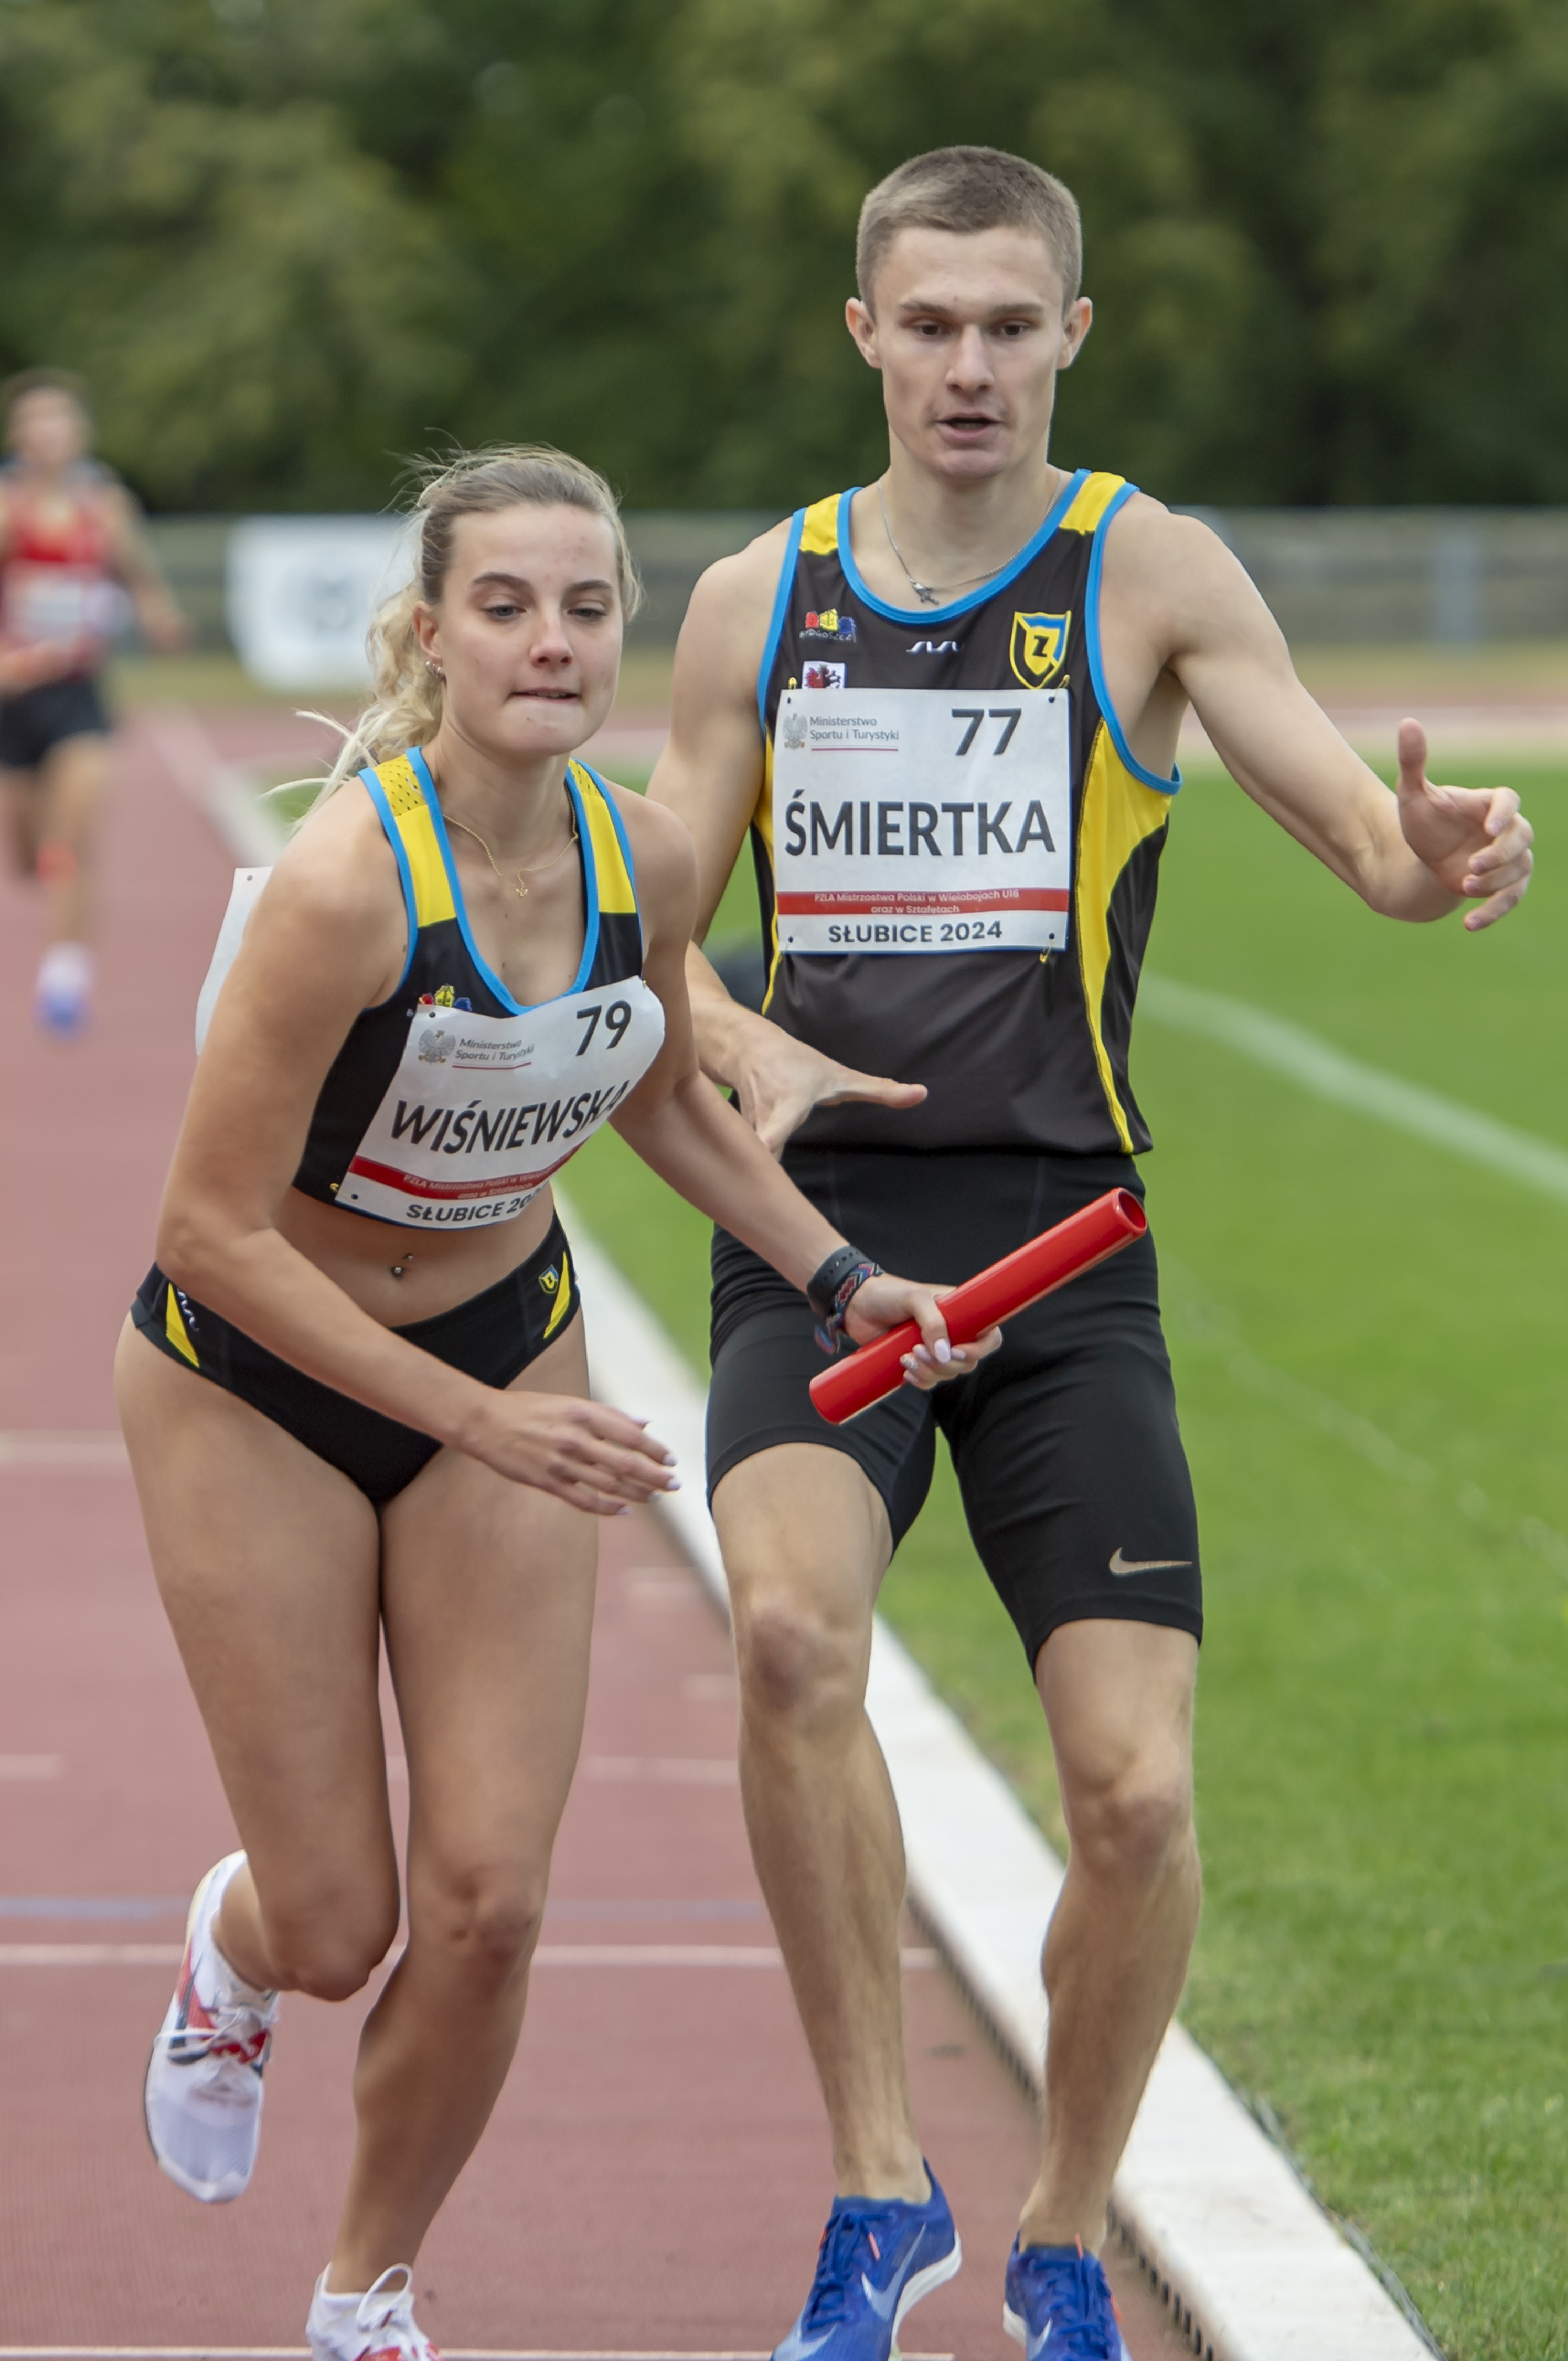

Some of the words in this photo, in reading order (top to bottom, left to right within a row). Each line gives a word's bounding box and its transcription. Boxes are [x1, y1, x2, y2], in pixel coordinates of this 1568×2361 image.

[1032, 634, 1050, 658] Z
[810, 716, 877, 726] Ministerstwo
[810, 730, 842, 741] Sportu
[846, 729, 849, 739] i
[852, 729, 899, 741] Turystyki
[951, 708, 1022, 756] 77
[785, 789, 1056, 856] ŚMIERTKA
[814, 893, 835, 902] PZLA
[837, 892, 895, 902] Mistrzostwa
[897, 892, 925, 902] Polski
[938, 890, 1000, 902] Wielobojach
[1002, 889, 1019, 898] U16
[906, 904, 960, 913] Sztafetach
[828, 924, 932, 943] SŁUBICE
[940, 920, 1002, 942] 2024
[575, 999, 631, 1057] 79
[459, 1038, 522, 1050] Ministerstwo
[455, 1050, 489, 1060] Sportu
[406, 1201, 505, 1222] SŁUBICE
